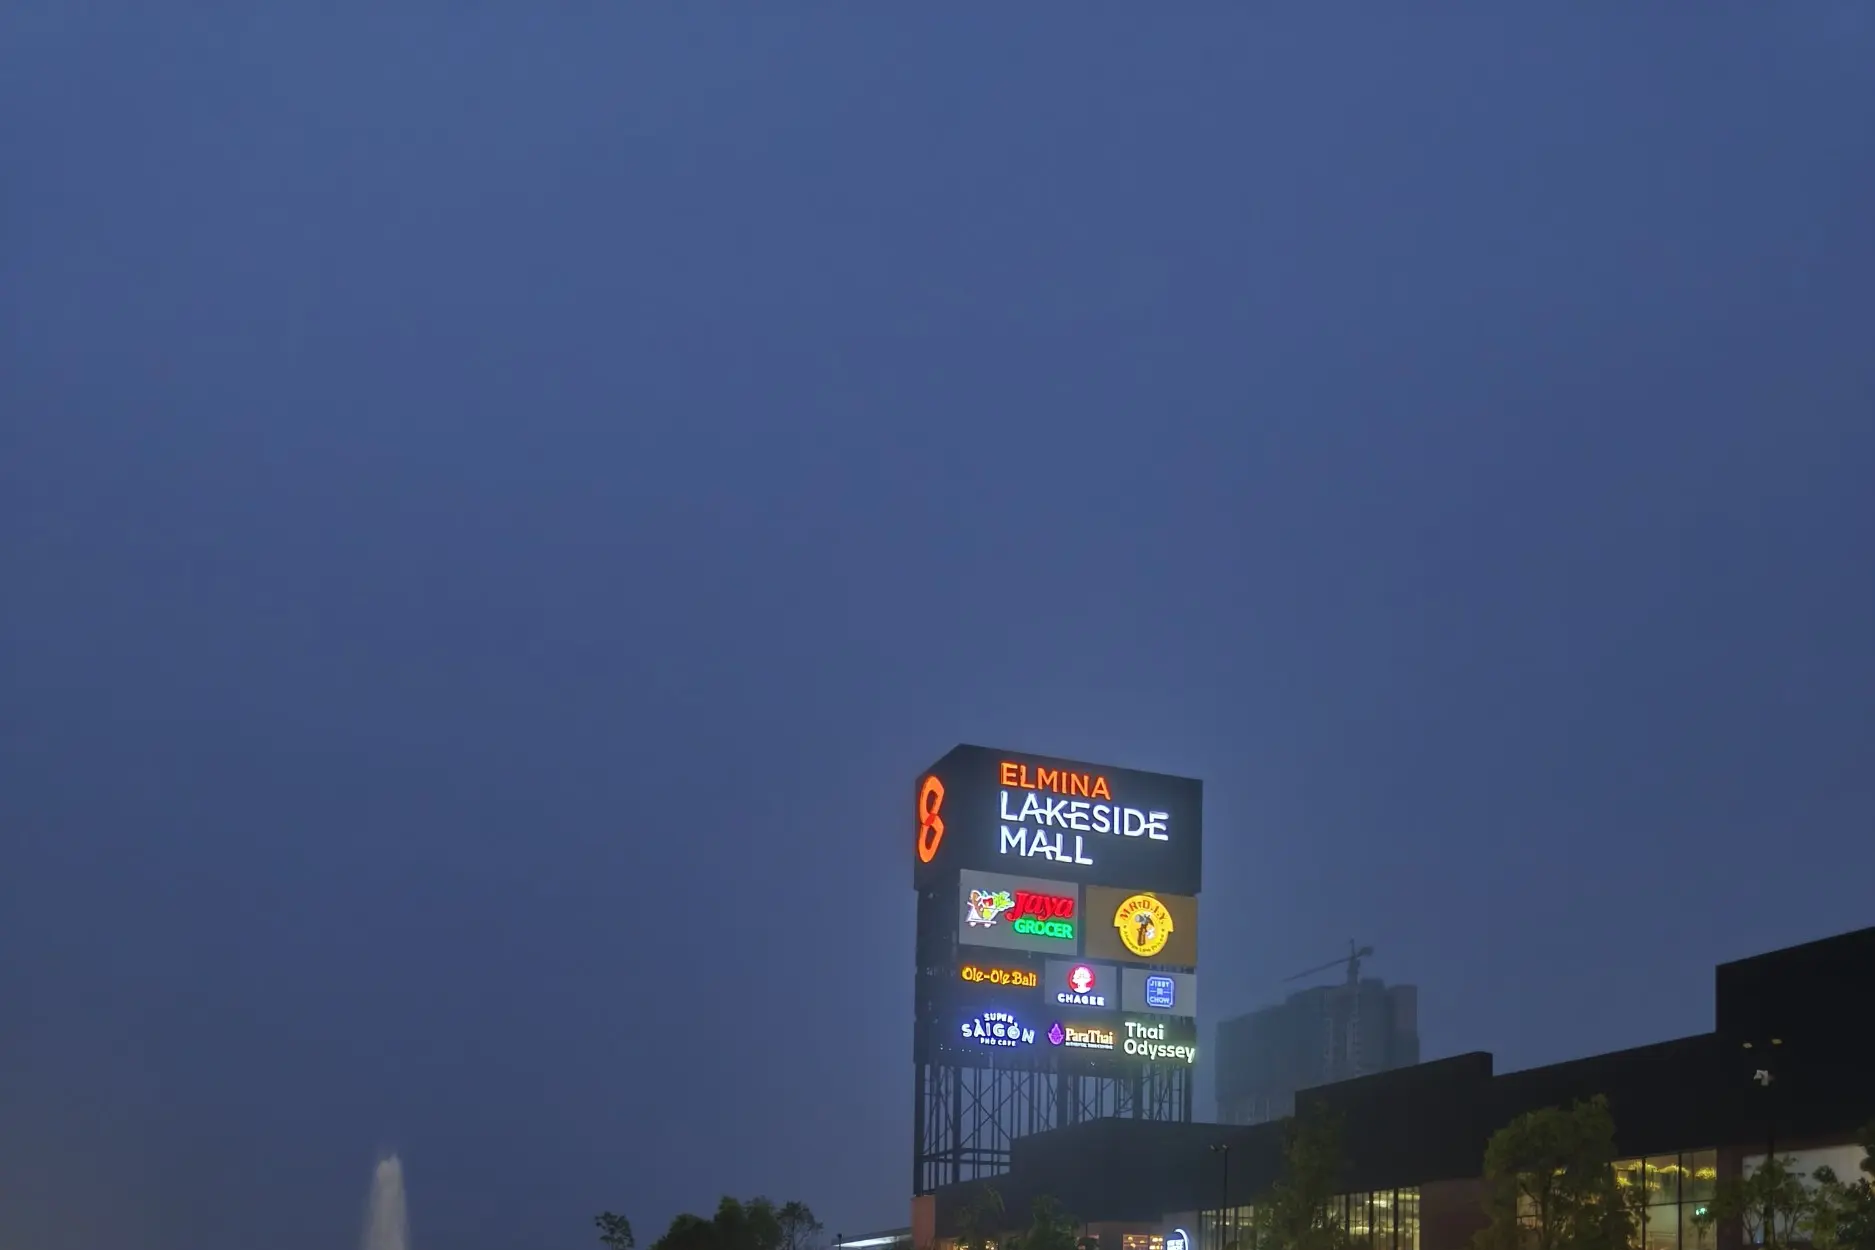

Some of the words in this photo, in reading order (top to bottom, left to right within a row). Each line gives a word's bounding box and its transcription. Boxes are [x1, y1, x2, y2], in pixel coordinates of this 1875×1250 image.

[1001, 762, 1111, 800] ELMINA
[1000, 791, 1169, 841] LAKESIDE
[1000, 825, 1094, 865] MALL
[1006, 892, 1074, 921] Jaya
[1014, 918, 1073, 939] GROCER
[961, 966, 1010, 985] Ole-Ole
[1011, 971, 1037, 987] Bali
[1057, 992, 1105, 1007] CHAGEE
[983, 1012, 1014, 1024] SUPER
[1124, 1021, 1165, 1040] Thai
[1123, 1038, 1196, 1064] Odyssey
